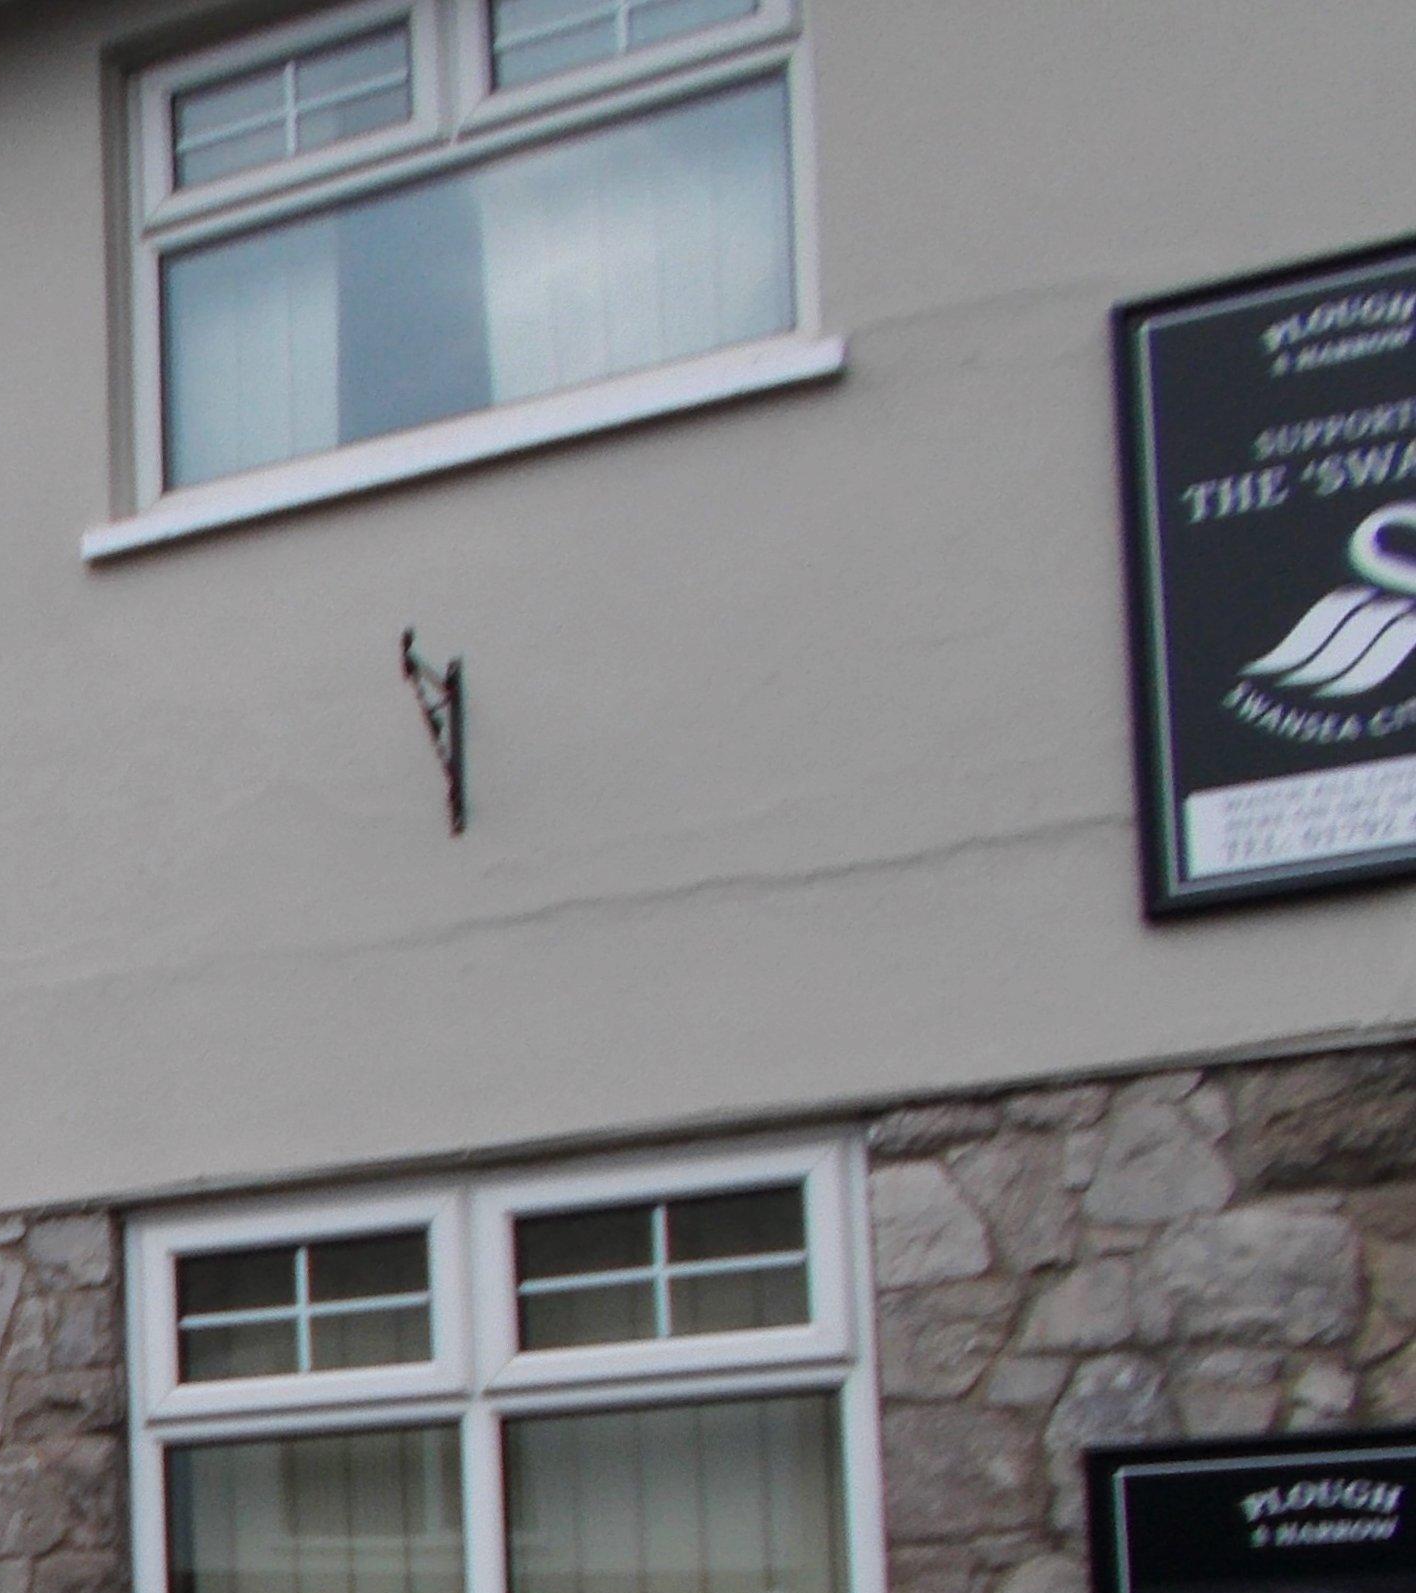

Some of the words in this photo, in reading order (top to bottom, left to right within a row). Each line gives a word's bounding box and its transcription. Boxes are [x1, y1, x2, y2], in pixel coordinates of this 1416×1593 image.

[1183, 464, 1290, 523] THE
[1221, 680, 1364, 744] SWANSEA
[1240, 1478, 1404, 1523] PLOUGH
[1275, 1515, 1399, 1546] HARROW
